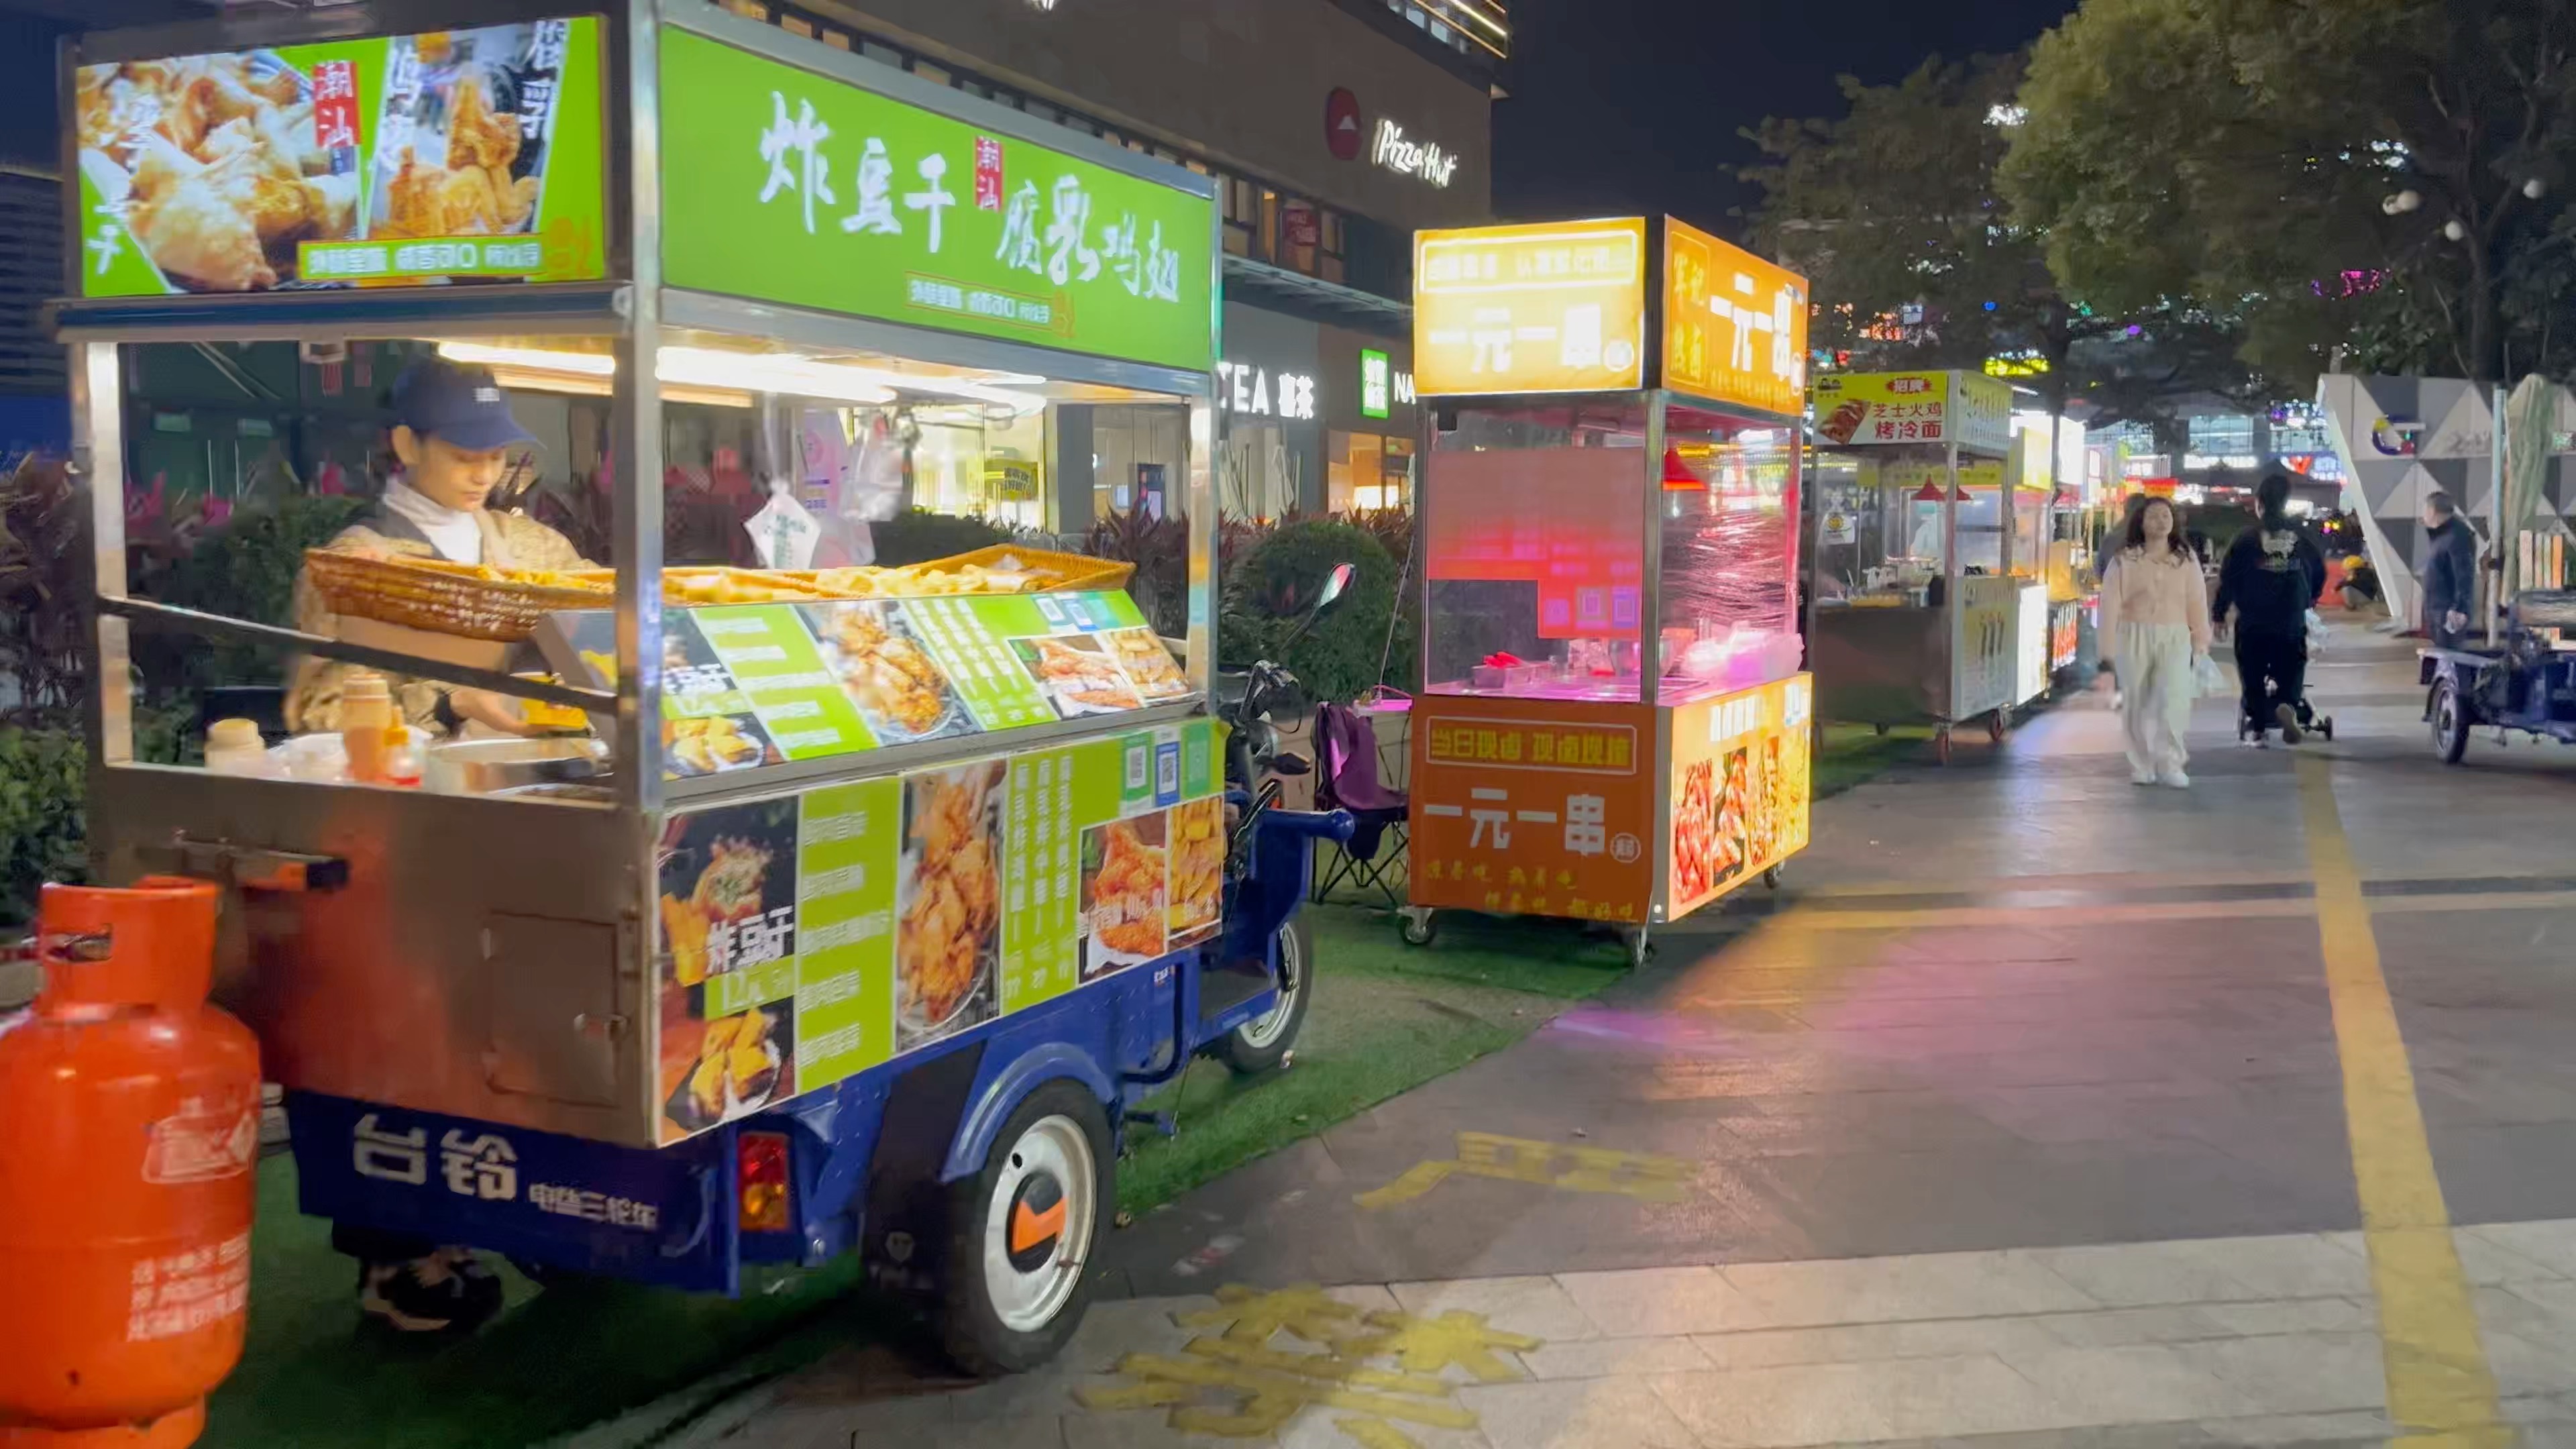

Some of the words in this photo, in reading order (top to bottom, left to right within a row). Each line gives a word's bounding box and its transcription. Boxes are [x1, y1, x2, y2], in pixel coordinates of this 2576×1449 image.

[1373, 119, 1424, 174] Pizza
[1424, 142, 1458, 188] Hut
[1873, 402, 1942, 419] 芝士火鸡
[1893, 378, 1925, 395] 招牌
[1875, 420, 1942, 439] 烤冷面
[1424, 788, 1605, 857] 一元一串
[706, 906, 796, 974] 炸豆干
[354, 1114, 517, 1200] 台铃
